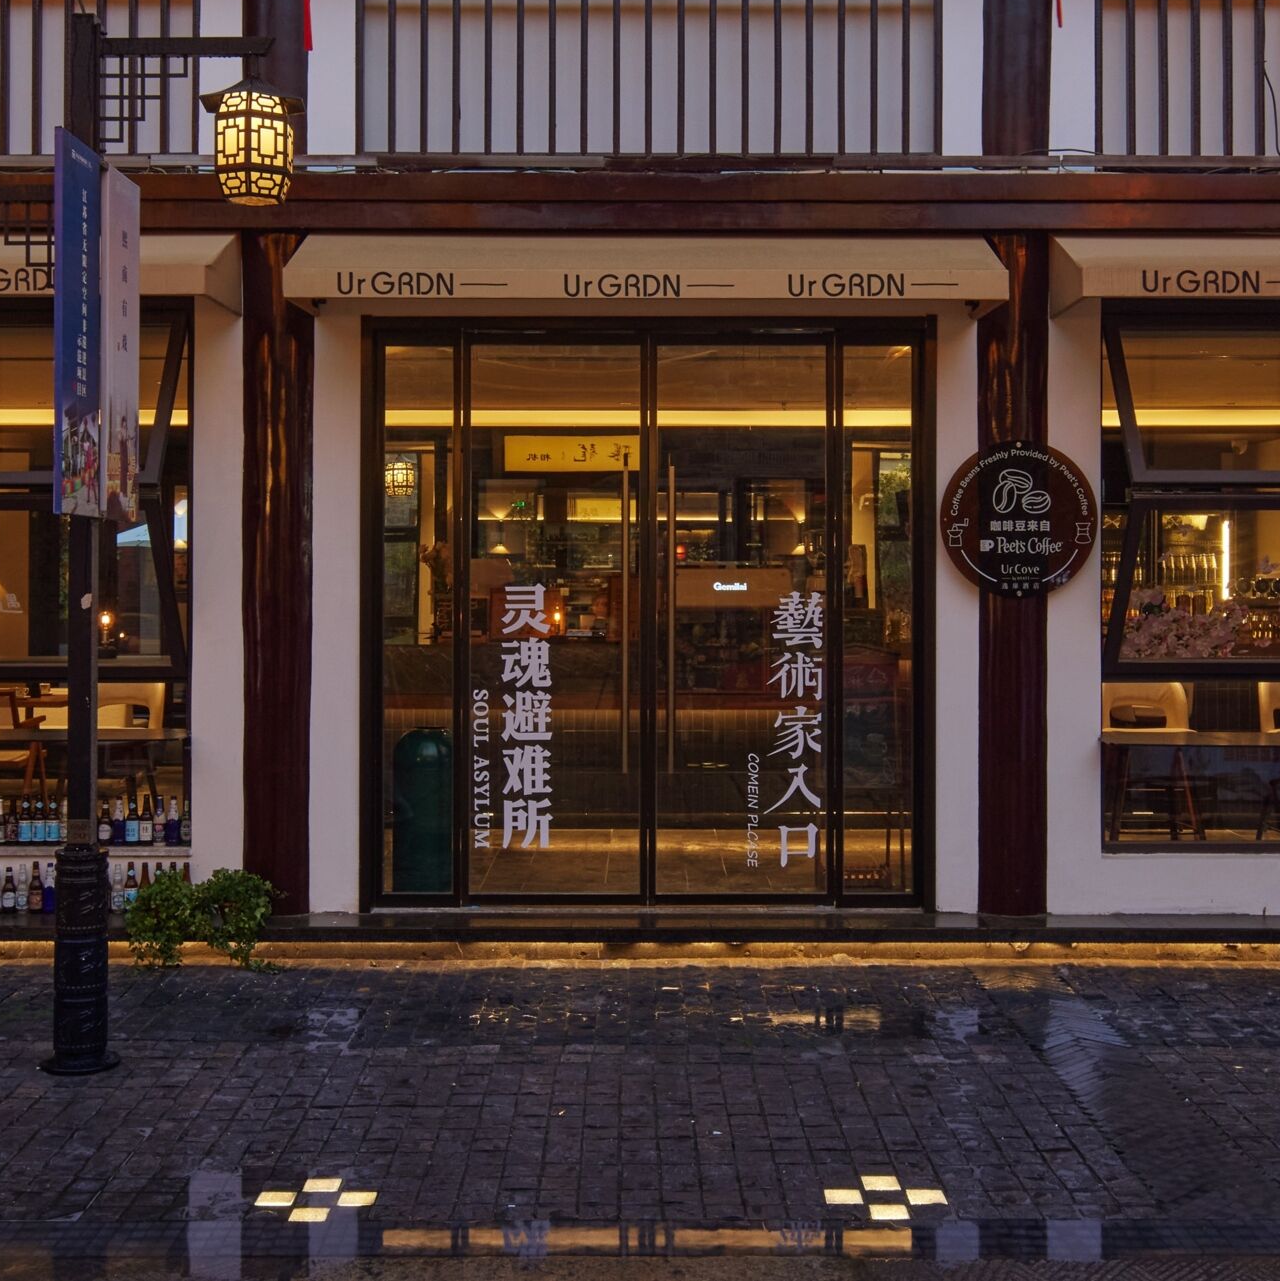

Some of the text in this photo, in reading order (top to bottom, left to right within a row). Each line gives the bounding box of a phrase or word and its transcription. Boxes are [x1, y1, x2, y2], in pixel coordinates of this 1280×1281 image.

[951, 488, 964, 516] Coffee
[960, 466, 981, 488] Beans
[979, 451, 1009, 468] Freshly
[1011, 449, 1048, 462] Provided
[1049, 456, 1060, 469] by
[1076, 488, 1088, 516] Coffee
[990, 520, 1051, 532] 咖啡豆来自
[1028, 537, 1063, 555] Coffee
[473, 689, 491, 849] SOUL ASYLUM
[501, 583, 553, 850] 灵魂避难所
[763, 591, 824, 868] 藝術家入口
